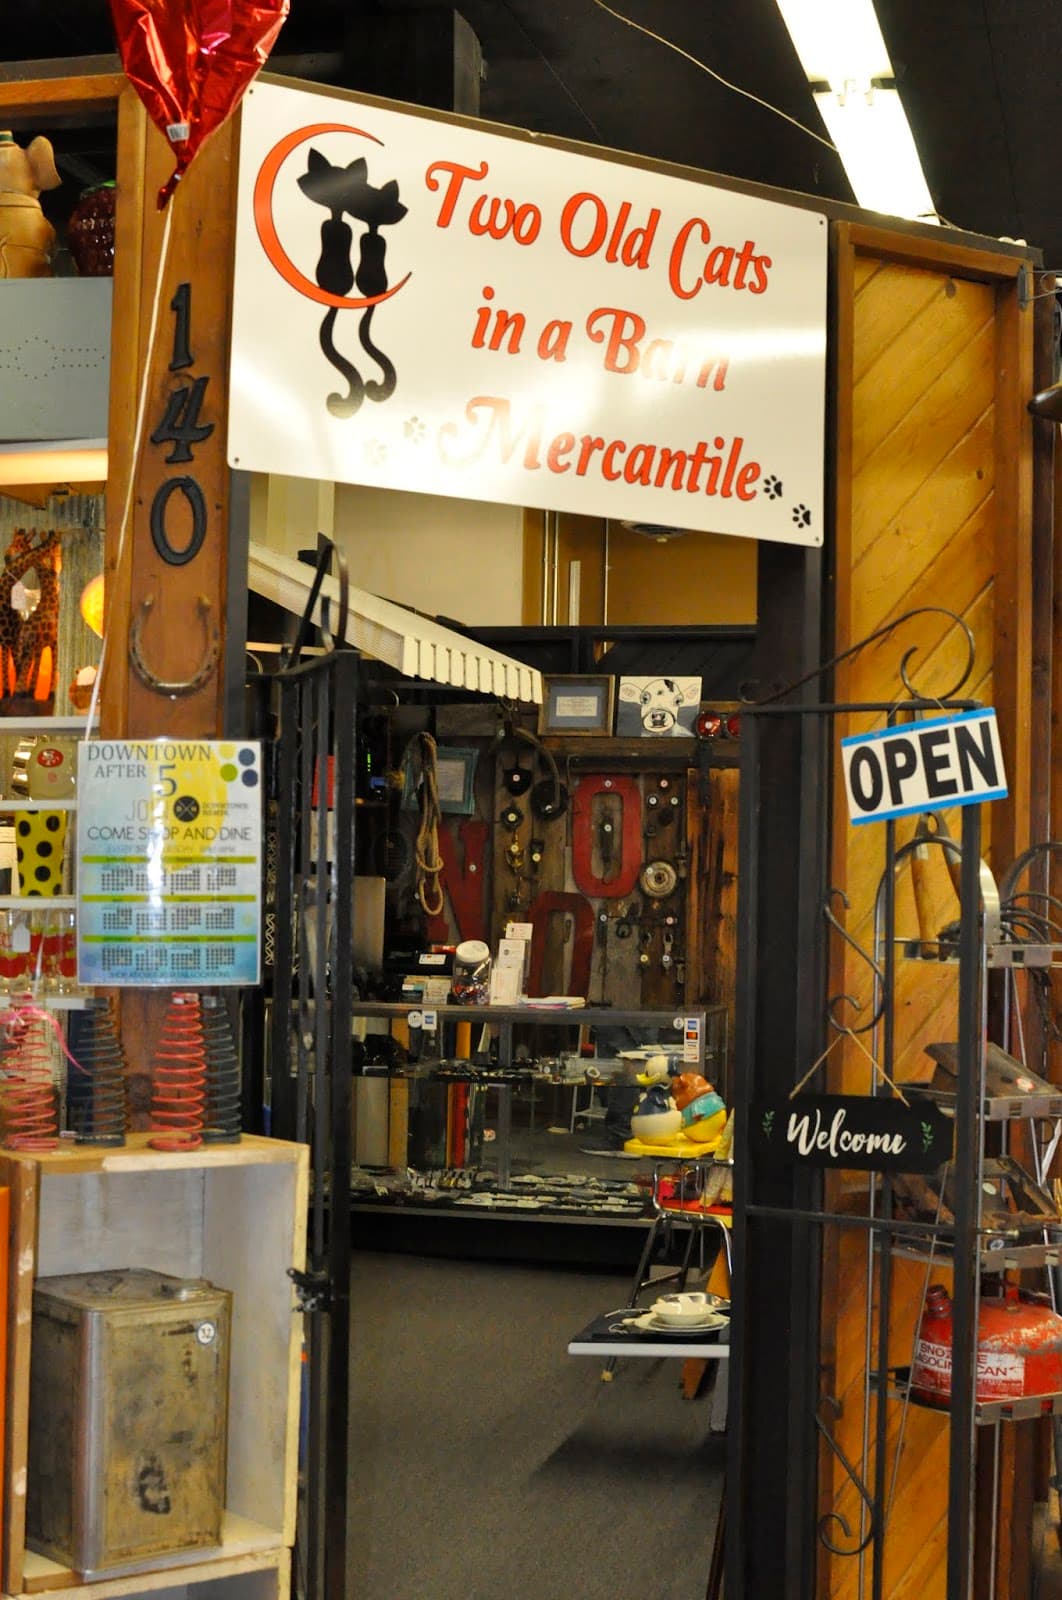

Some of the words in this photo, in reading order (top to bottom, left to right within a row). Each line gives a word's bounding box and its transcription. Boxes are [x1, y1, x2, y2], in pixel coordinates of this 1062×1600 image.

[425, 160, 542, 246] Two
[559, 191, 662, 270] Old
[668, 217, 773, 301] Cats
[471, 285, 527, 355] in
[537, 319, 573, 363] a
[438, 395, 762, 502] Mercantile
[87, 744, 212, 762] DOWNTOWN
[94, 764, 147, 779] AFTER
[156, 764, 178, 798] 5
[849, 720, 1000, 812] OPEN
[87, 826, 135, 841] COME
[183, 826, 217, 841] AND
[219, 826, 253, 841] DINE
[787, 1108, 907, 1158] Welcome
